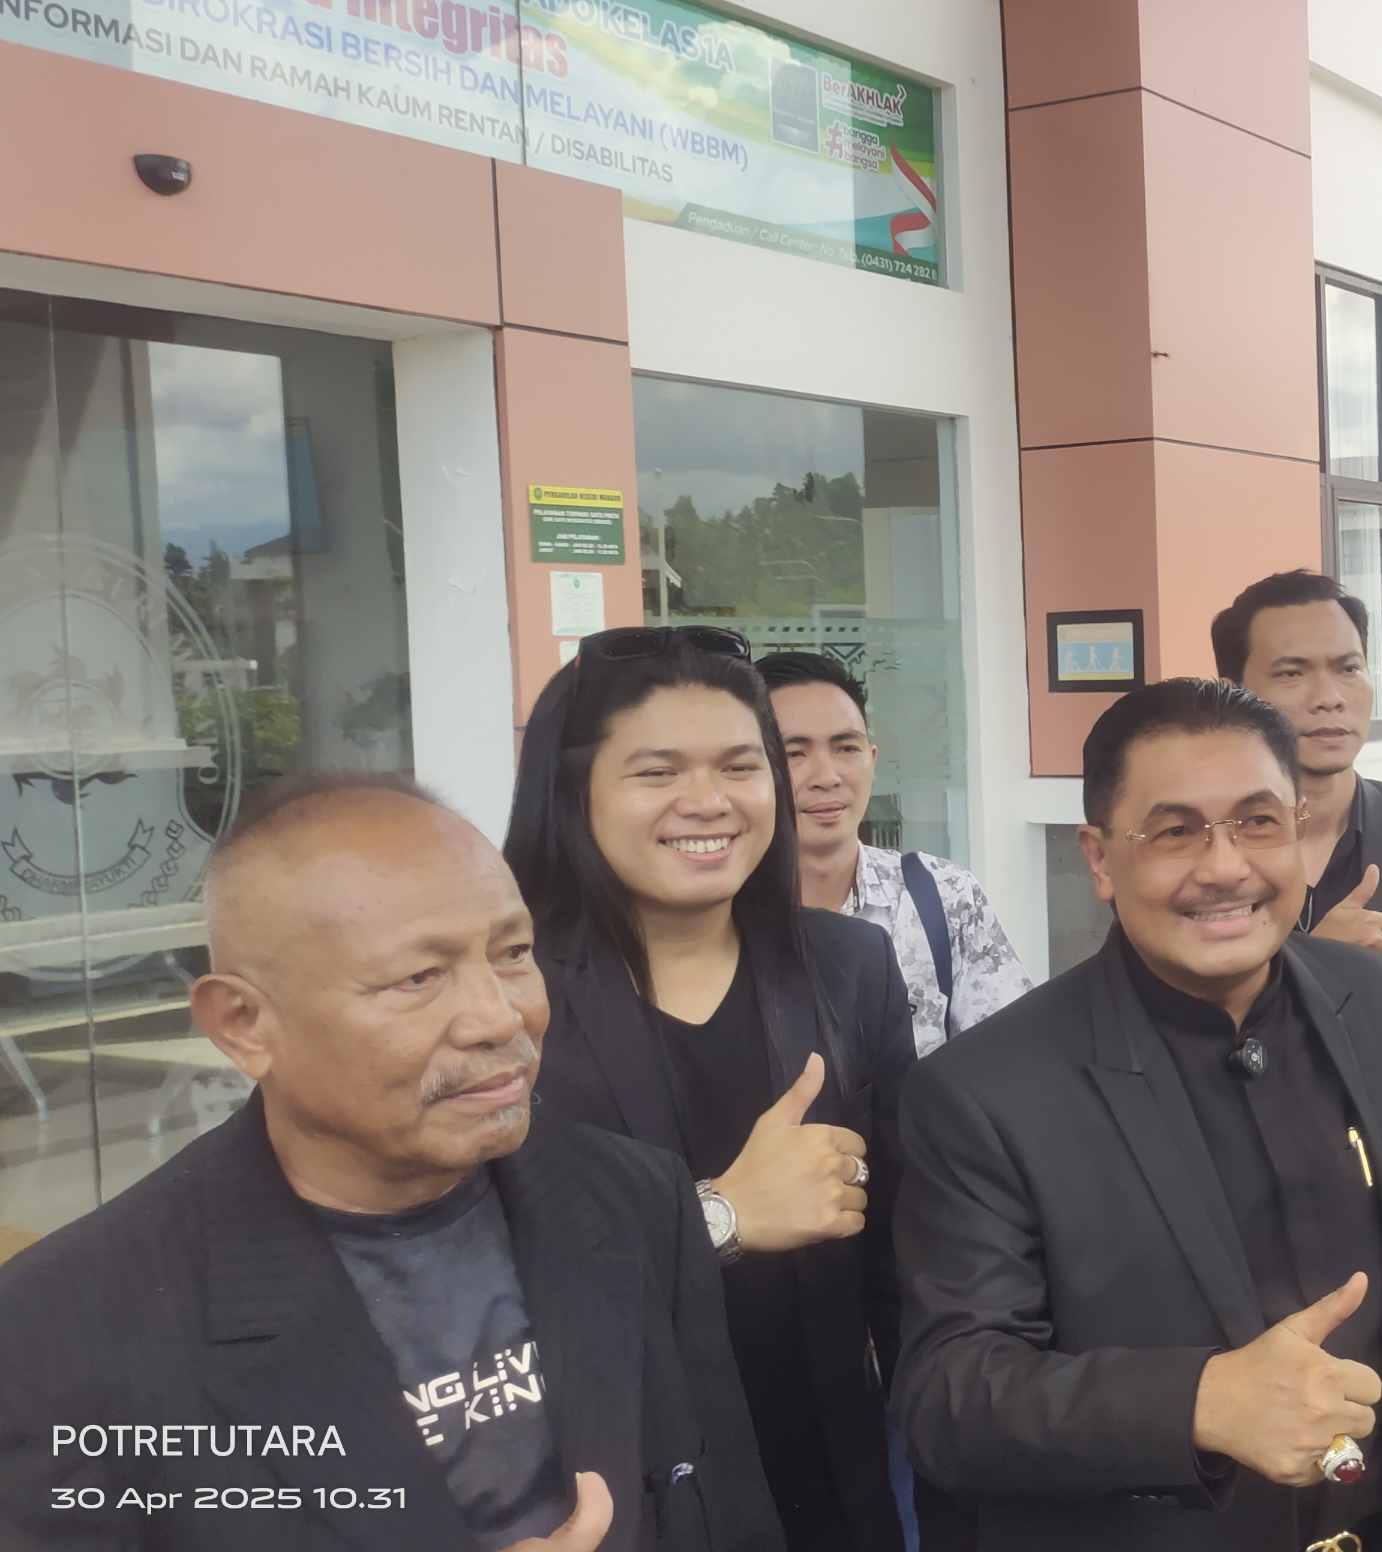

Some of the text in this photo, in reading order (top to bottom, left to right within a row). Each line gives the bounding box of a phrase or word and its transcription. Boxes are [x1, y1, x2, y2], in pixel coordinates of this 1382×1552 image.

[346, 0, 569, 78] ntegritas
[179, 36, 243, 75] DAN
[251, 55, 351, 101] RAMAH
[357, 82, 433, 123] KAUM
[437, 104, 530, 148] RENTAN
[550, 133, 674, 183] DISABILITAS
[340, 31, 451, 86] BERSIH
[459, 65, 524, 105] DAN
[526, 83, 654, 142] MELAYANI
[660, 122, 750, 173] (WBBM)
[464, 1373, 546, 1431] KIN
[472, 1340, 540, 1391] LIV
